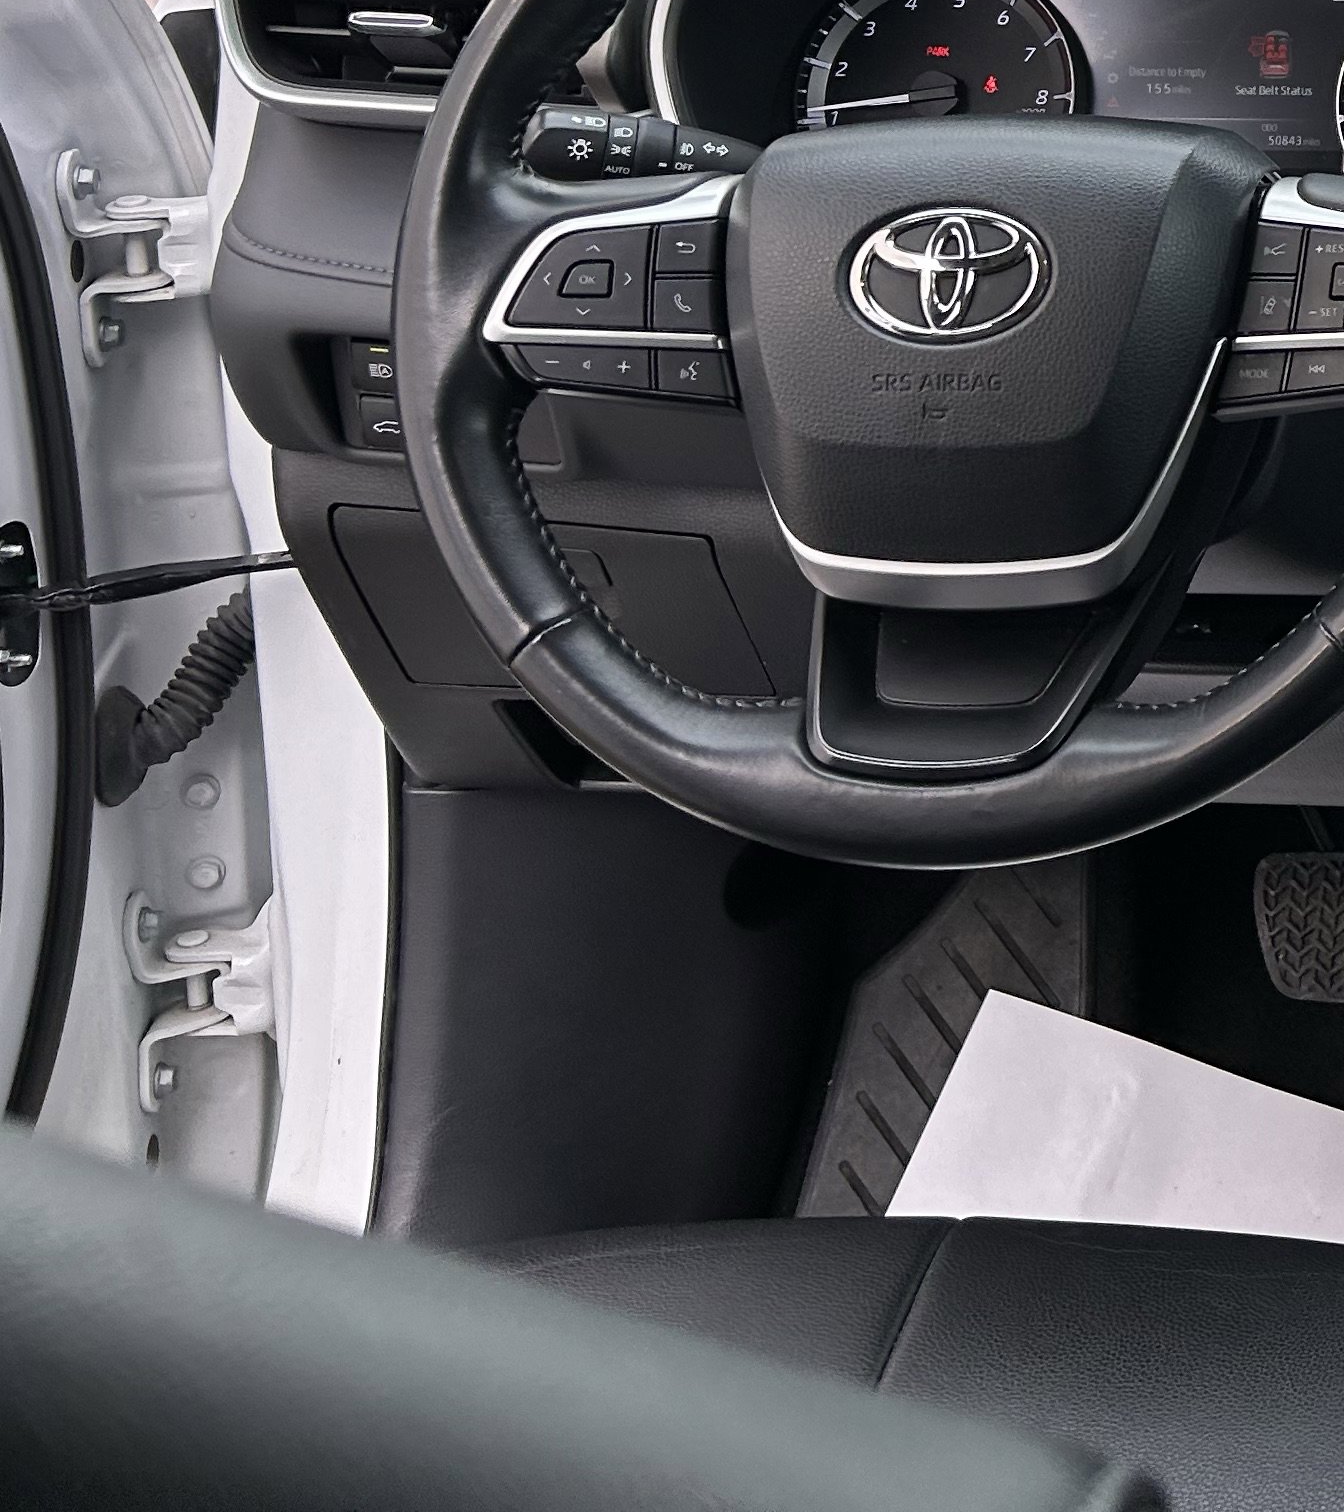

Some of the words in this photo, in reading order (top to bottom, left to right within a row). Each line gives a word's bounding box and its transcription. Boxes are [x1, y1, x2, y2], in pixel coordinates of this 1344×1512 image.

[996, 10, 1010, 26] 6
[863, 20, 877, 37] 3
[1023, 46, 1037, 63] 7
[834, 61, 849, 77] 2
[1129, 67, 1166, 77] Distance
[1167, 68, 1177, 77] to
[1178, 68, 1207, 79] Empty
[1147, 83, 1172, 94] 155
[1235, 85, 1257, 96] Seat
[1258, 85, 1279, 96] Belt
[1280, 85, 1313, 96] Status
[1035, 89, 1049, 105] 8
[829, 111, 839, 126] 1
[1268, 135, 1302, 146] 50843
[603, 164, 631, 176] AUTO
[674, 162, 695, 172] OFF
[578, 274, 596, 285] OK
[1239, 369, 1270, 379] MODE
[871, 373, 912, 392] SRS
[918, 373, 1003, 392] AIRBAG
